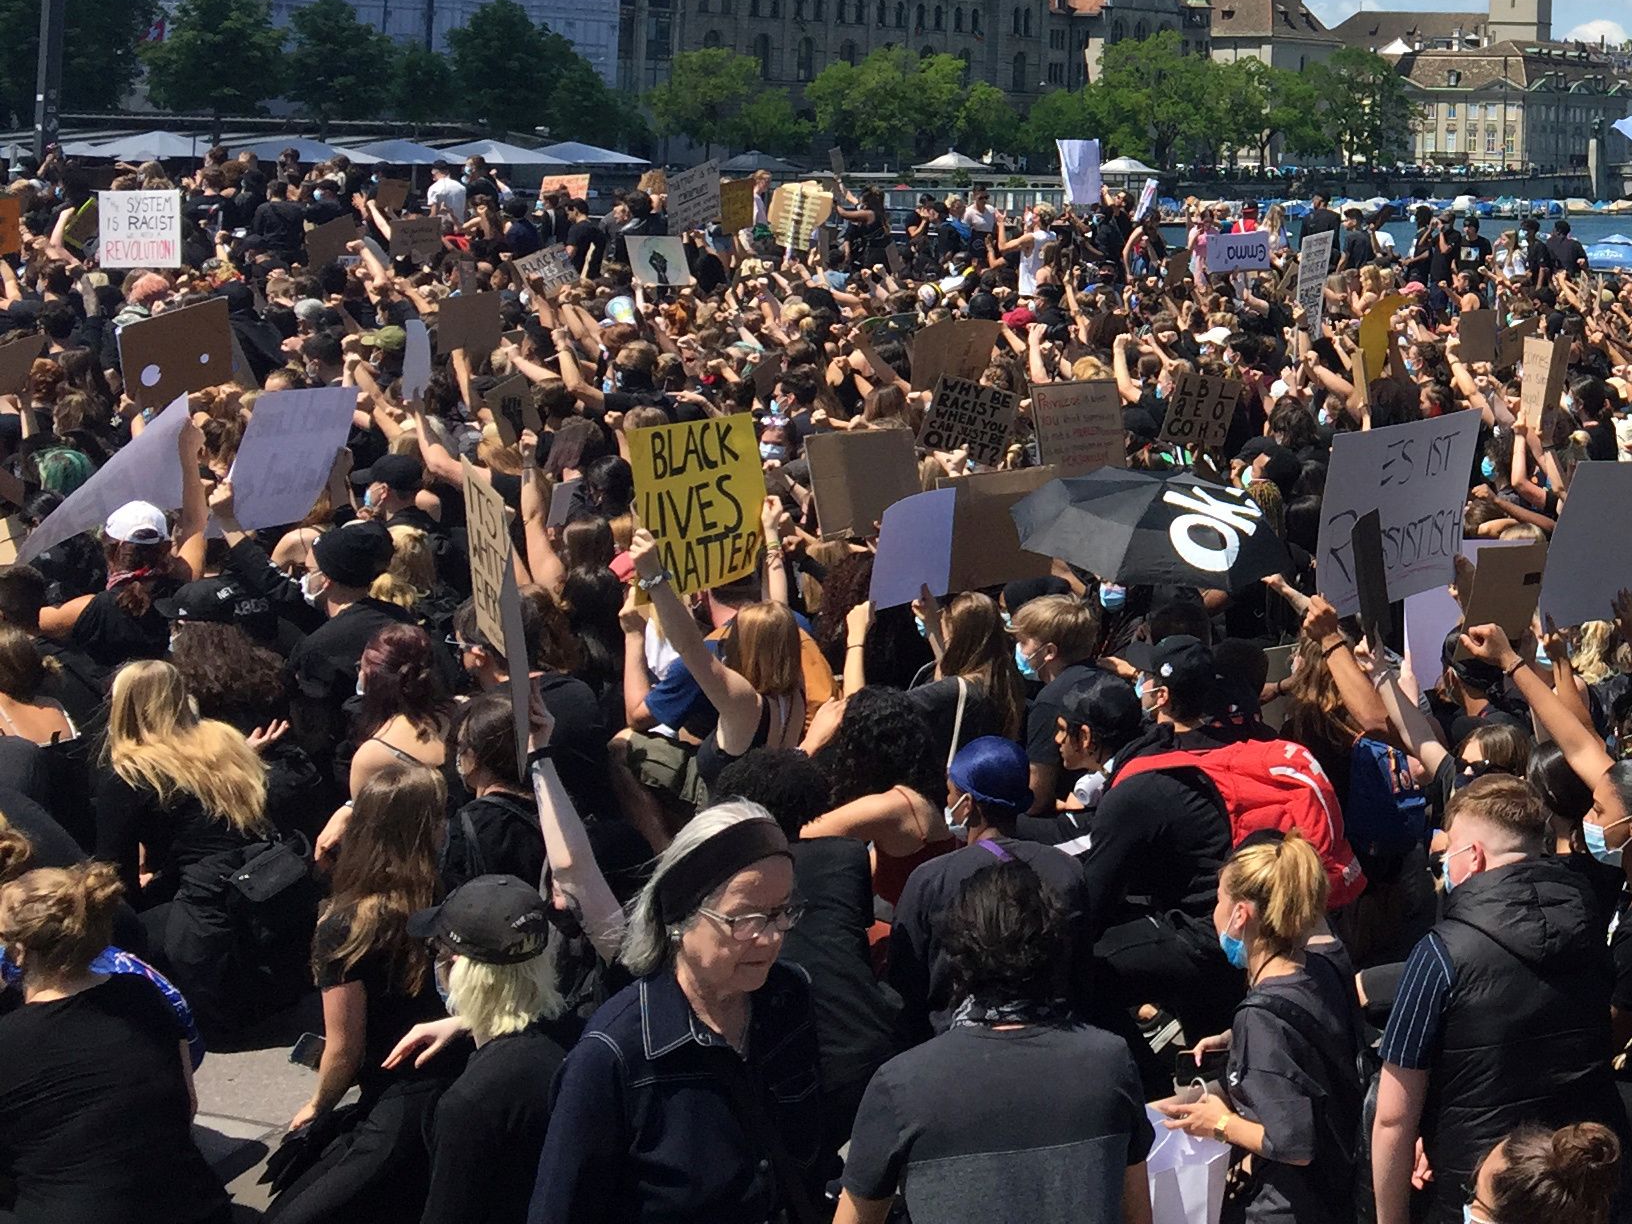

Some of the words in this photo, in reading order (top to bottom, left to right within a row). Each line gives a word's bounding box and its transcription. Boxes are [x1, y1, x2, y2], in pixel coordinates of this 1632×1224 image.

[127, 196, 173, 214] SYSTEM
[107, 216, 119, 231] IS
[128, 215, 175, 231] RACIST
[105, 239, 176, 261] REVOLUTION!
[936, 393, 1000, 418] RACIST
[941, 378, 986, 399] WHY
[989, 390, 1013, 408] BE
[928, 420, 954, 433] CAN
[957, 426, 987, 442] JUST
[988, 432, 1005, 446] BE
[935, 408, 977, 427] WHEN
[981, 419, 1008, 434] YOU
[650, 421, 740, 480] BLACK
[1380, 438, 1415, 486] ES
[1425, 430, 1461, 477] IST
[644, 473, 743, 540] LIVES
[655, 530, 764, 594] MATTER
